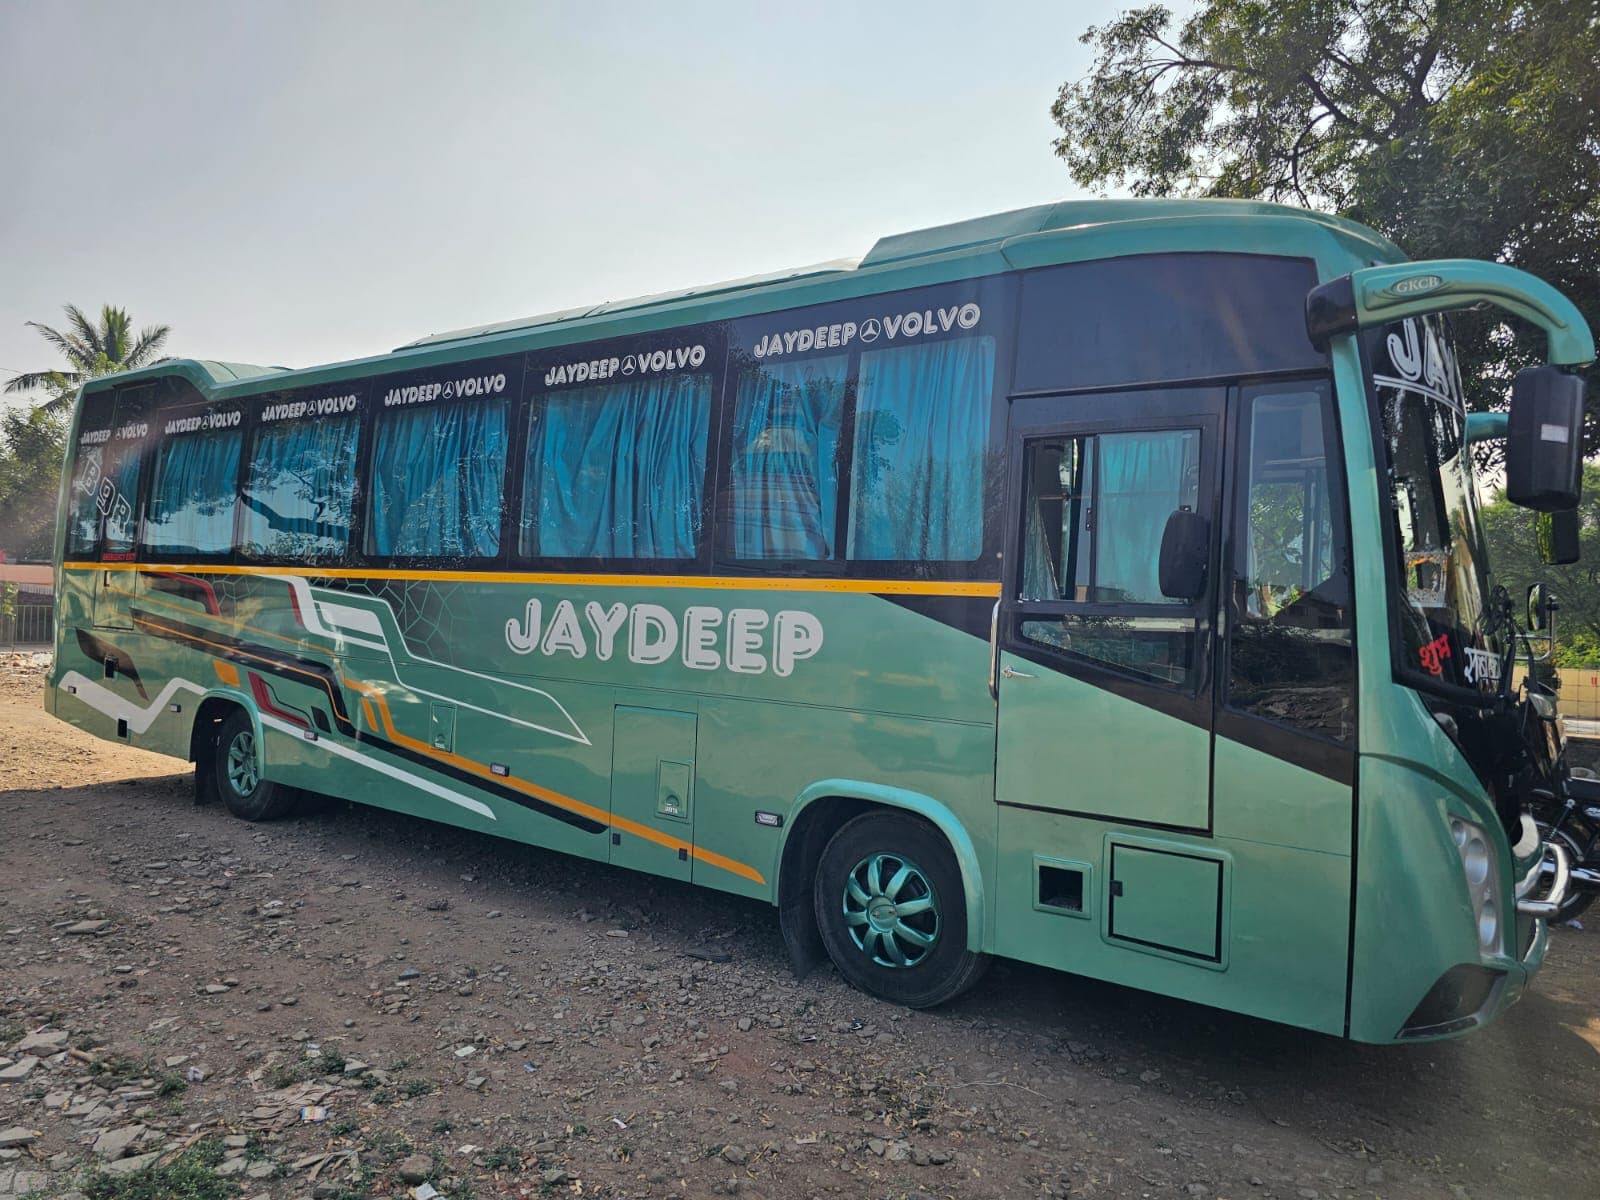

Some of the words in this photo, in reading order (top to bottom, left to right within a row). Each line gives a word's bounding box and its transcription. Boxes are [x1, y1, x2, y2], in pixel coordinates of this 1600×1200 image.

[1396, 275, 1439, 293] GKCB
[754, 321, 857, 358] JAYDEEP
[883, 302, 981, 339] VOLVO
[544, 356, 620, 387] JAYDEEP
[637, 344, 706, 373] VOLVO
[384, 381, 441, 407] JAYDEEP
[455, 373, 506, 397] VOLVO
[164, 416, 201, 435] JAYDEEP
[209, 410, 241, 429] VOLVO
[261, 402, 307, 422] JAYDEEP
[317, 394, 356, 413] VOLVO
[80, 429, 111, 445] JAYDEEP
[121, 423, 149, 440] VOLVO
[505, 597, 824, 677] JAYDEEP
